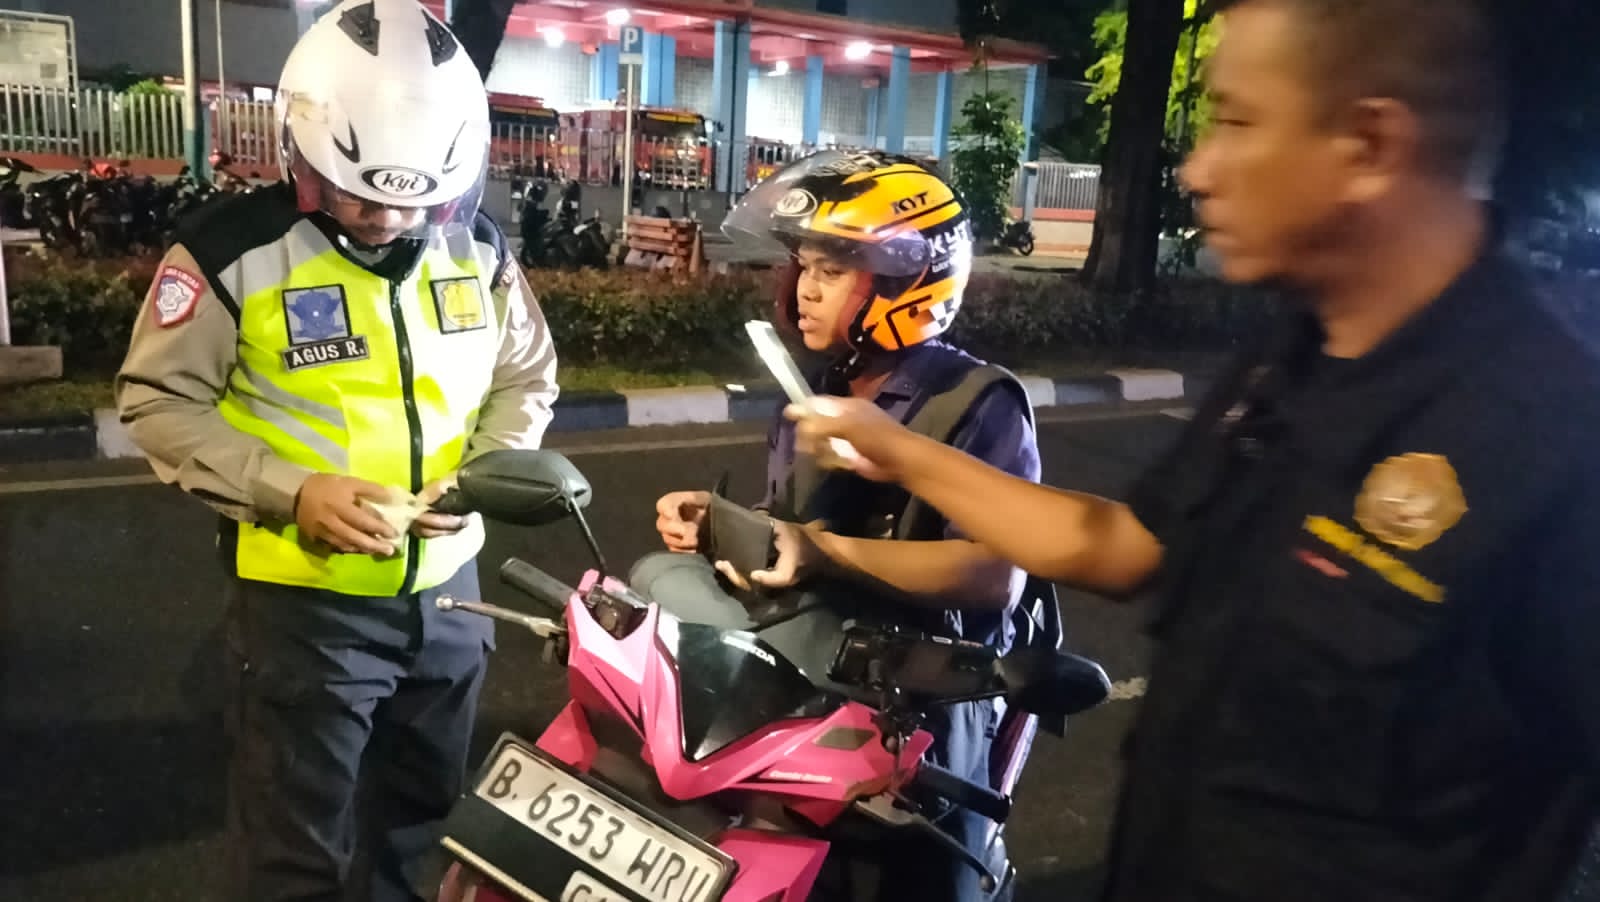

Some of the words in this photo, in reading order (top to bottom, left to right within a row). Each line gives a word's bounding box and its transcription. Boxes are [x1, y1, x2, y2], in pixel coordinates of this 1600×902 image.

[624, 27, 639, 52] P
[292, 343, 340, 366] AGUS
[345, 340, 365, 356] R.
[528, 782, 625, 860] 6253
[626, 838, 711, 902] WRU
